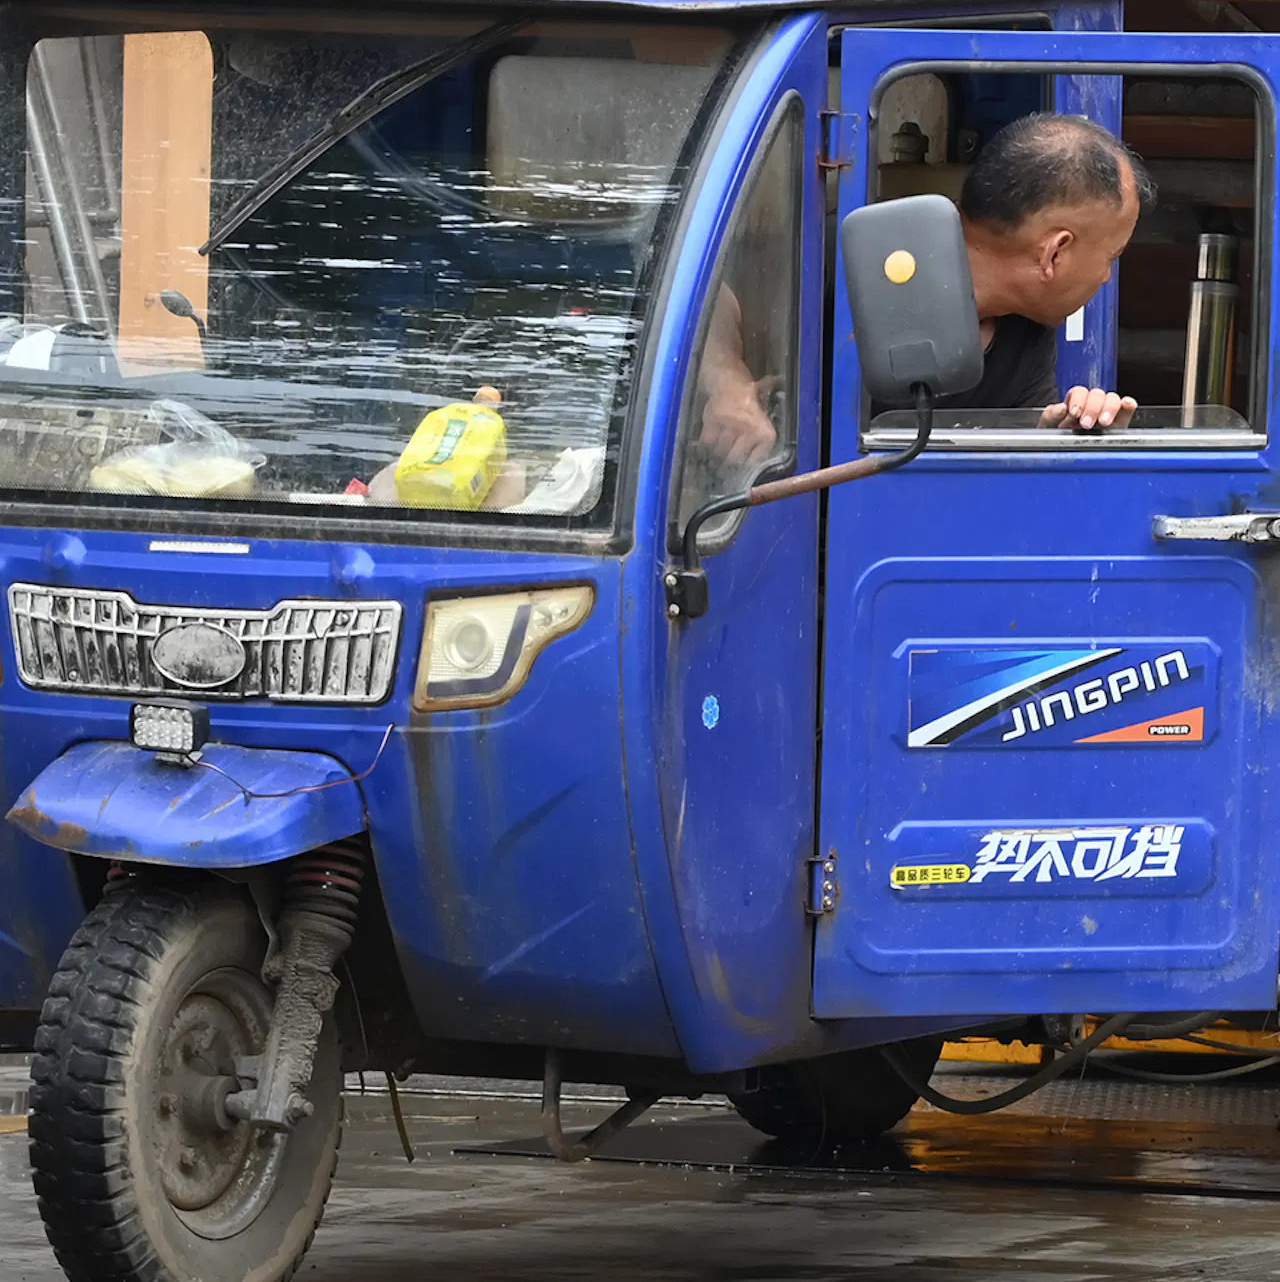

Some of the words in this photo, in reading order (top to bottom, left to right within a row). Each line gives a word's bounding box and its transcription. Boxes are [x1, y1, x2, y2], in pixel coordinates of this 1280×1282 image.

[1001, 650, 1190, 743] JINGPIN
[1149, 725, 1190, 735] POWER
[968, 826, 1185, 883] 势不可挡
